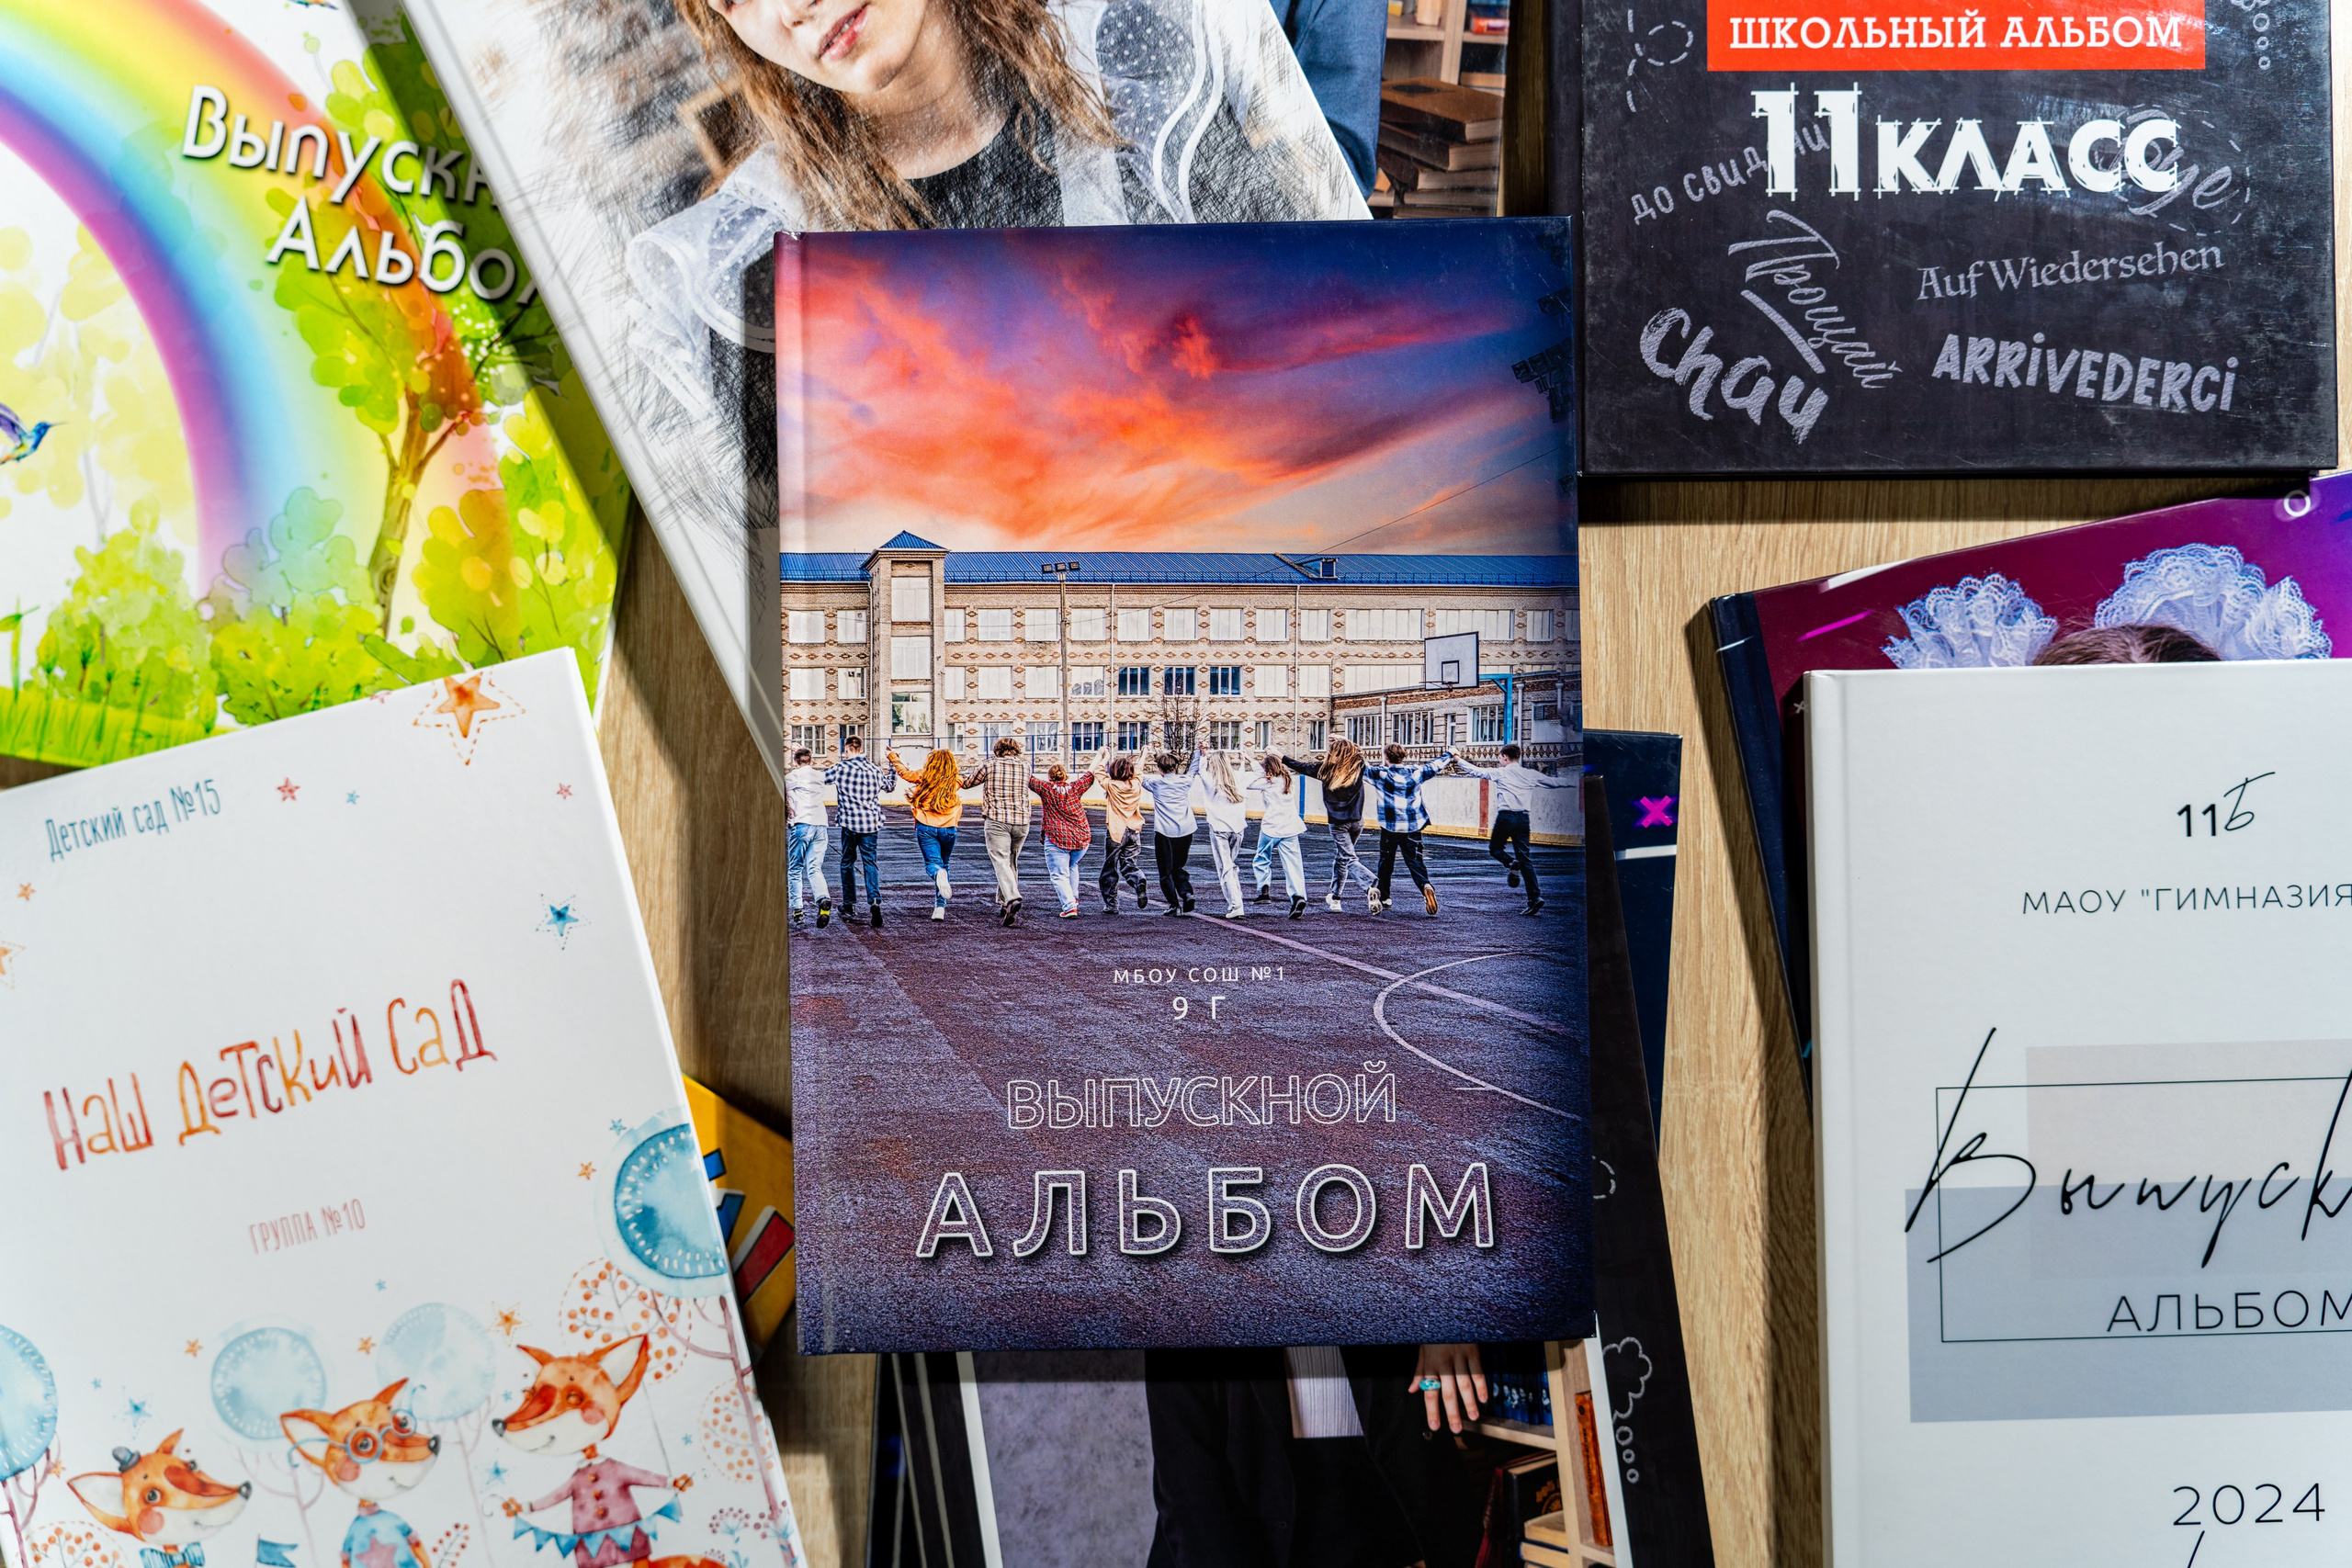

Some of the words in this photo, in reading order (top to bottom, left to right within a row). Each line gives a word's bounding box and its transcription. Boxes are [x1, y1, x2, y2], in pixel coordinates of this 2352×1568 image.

[1729, 9, 1986, 50] ШКОЛЬНЫЙ
[1999, 16, 2182, 49] АЛЬБОМ
[1750, 82, 1862, 201] 11
[1872, 111, 2182, 202] КЛАСС
[1917, 260, 1984, 300] Auf
[1986, 241, 2226, 292] Wiedersehen
[45, 806, 128, 863] Детский
[132, 800, 170, 835] сад
[170, 778, 221, 823] №15
[2022, 888, 2127, 915] МАОУ
[2140, 883, 2352, 911] "ГИМНАЗИЯ
[1113, 967, 1178, 984] МБОУ
[1188, 966, 1239, 982] СОШ
[1171, 996, 1189, 1021] 9
[1210, 996, 1227, 1020] Г
[1007, 1060, 1397, 1130] ВЫПУСКНОЙ
[248, 1212, 319, 1256] ГРУППА
[320, 1198, 367, 1237] №10
[916, 1162, 1496, 1258] АЛЬБОМ
[2173, 1483, 2326, 1527] 2024
